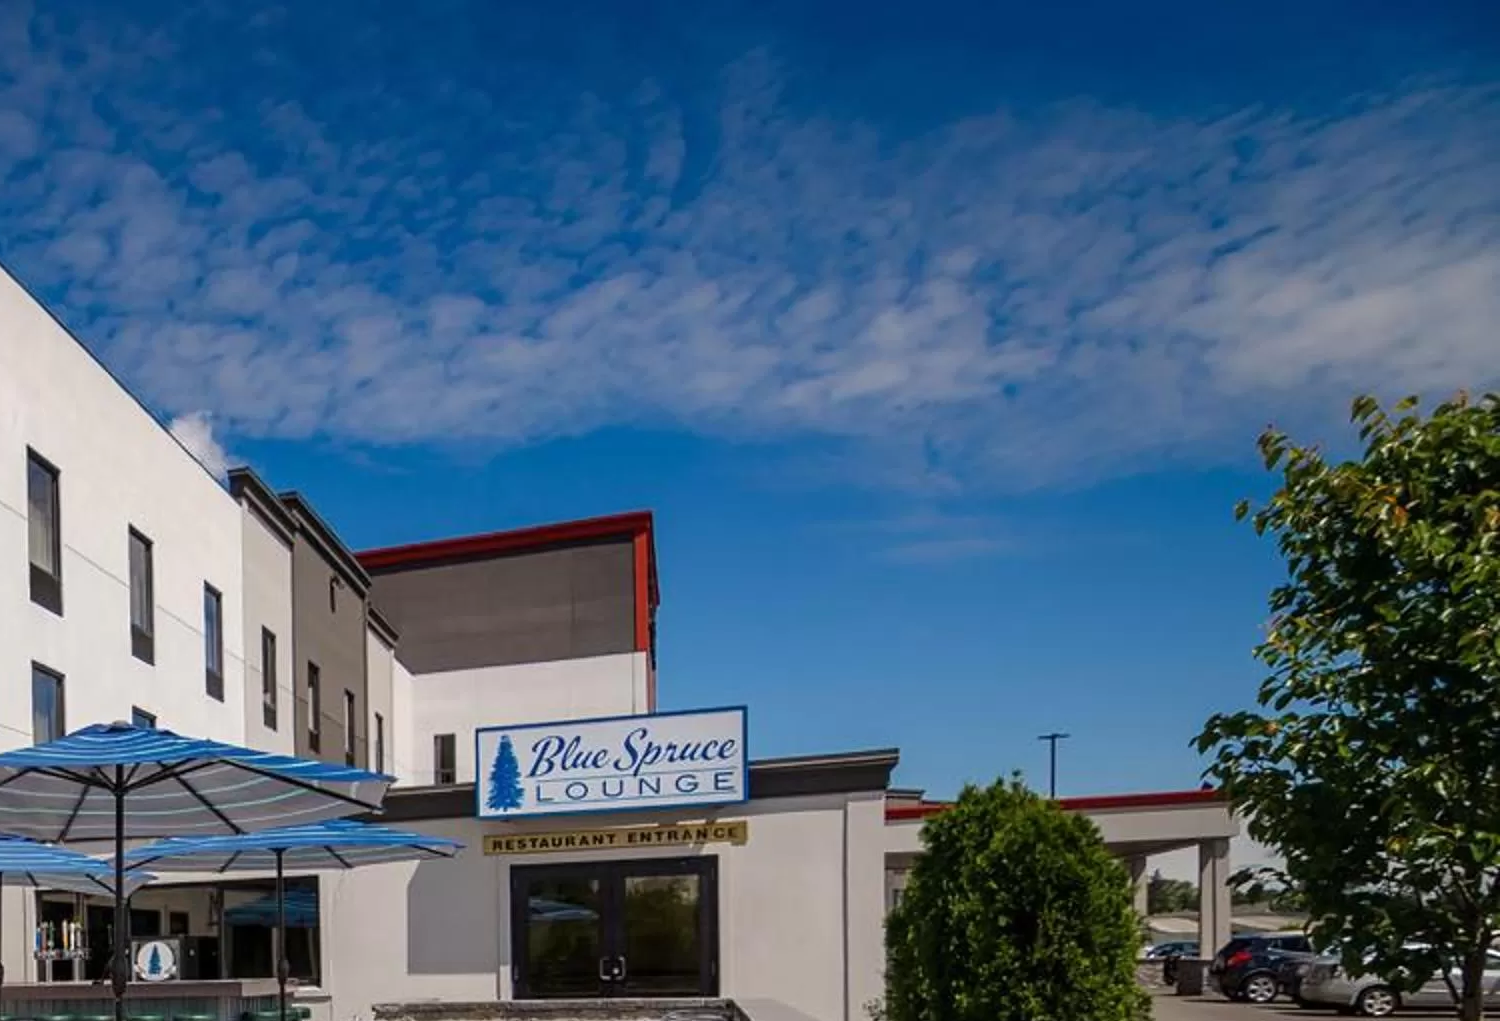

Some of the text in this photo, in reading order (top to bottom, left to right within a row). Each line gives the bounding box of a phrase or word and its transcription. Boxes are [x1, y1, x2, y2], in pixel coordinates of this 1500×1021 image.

[527, 727, 736, 778] Blue Spruce
[536, 772, 735, 802] LOUNGE
[492, 826, 738, 851] RESTAURANT ENTRANCE
